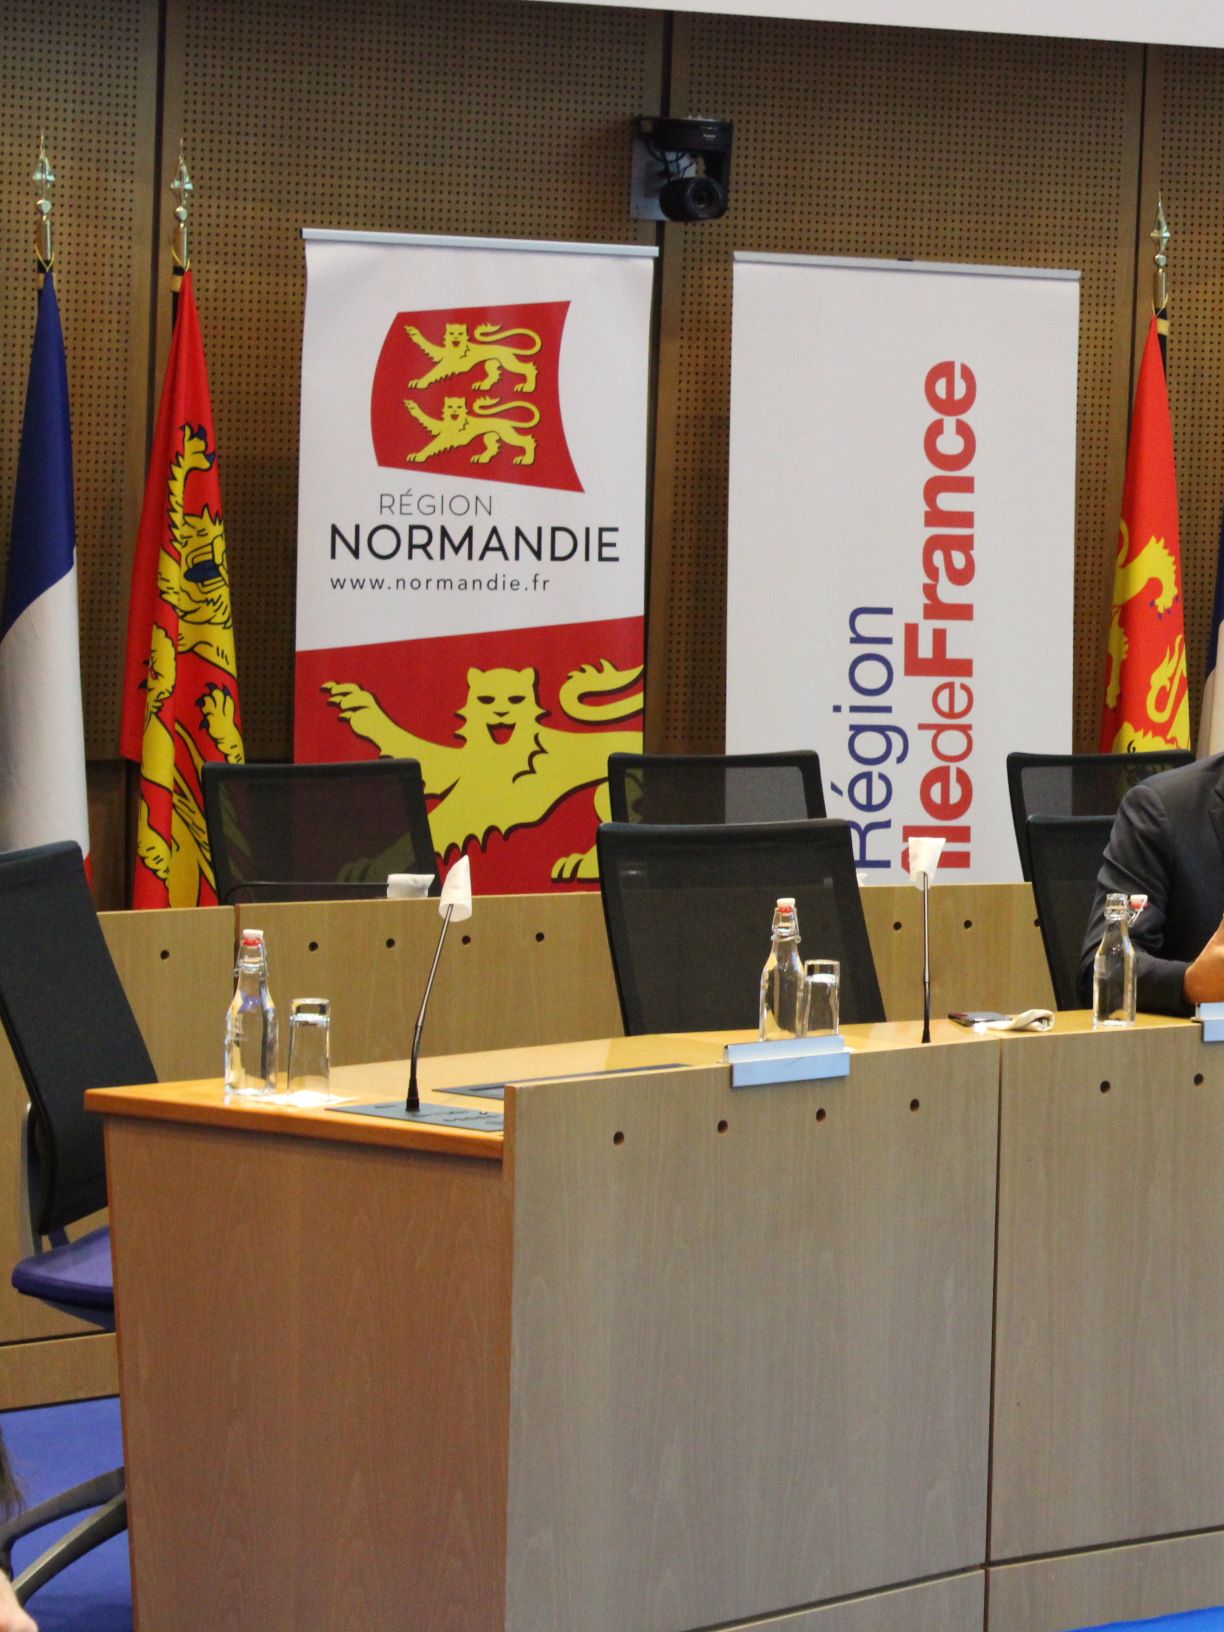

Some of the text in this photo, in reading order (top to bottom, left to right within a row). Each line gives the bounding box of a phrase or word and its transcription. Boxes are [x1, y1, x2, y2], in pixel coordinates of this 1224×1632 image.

[379, 488, 494, 517] RÉGION
[329, 523, 621, 563] NORMANDIE
[329, 572, 551, 592] www.normandie.fr
[830, 605, 909, 869] Région
